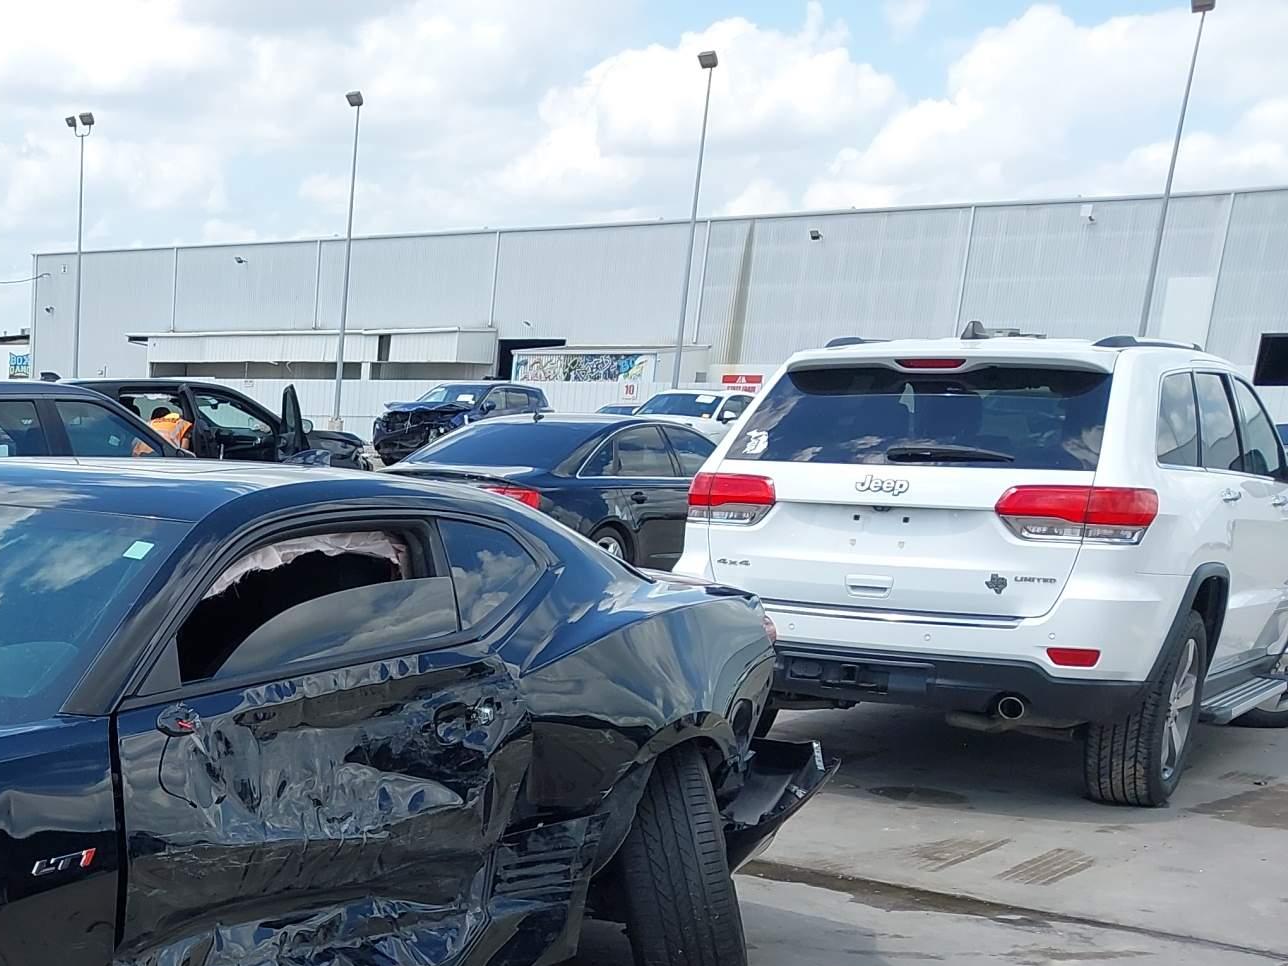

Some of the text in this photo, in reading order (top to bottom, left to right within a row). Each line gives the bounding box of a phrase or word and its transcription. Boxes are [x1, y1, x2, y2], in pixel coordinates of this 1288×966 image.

[624, 383, 635, 396] 10
[854, 473, 910, 497] Jeep
[31, 847, 97, 877] LT1
